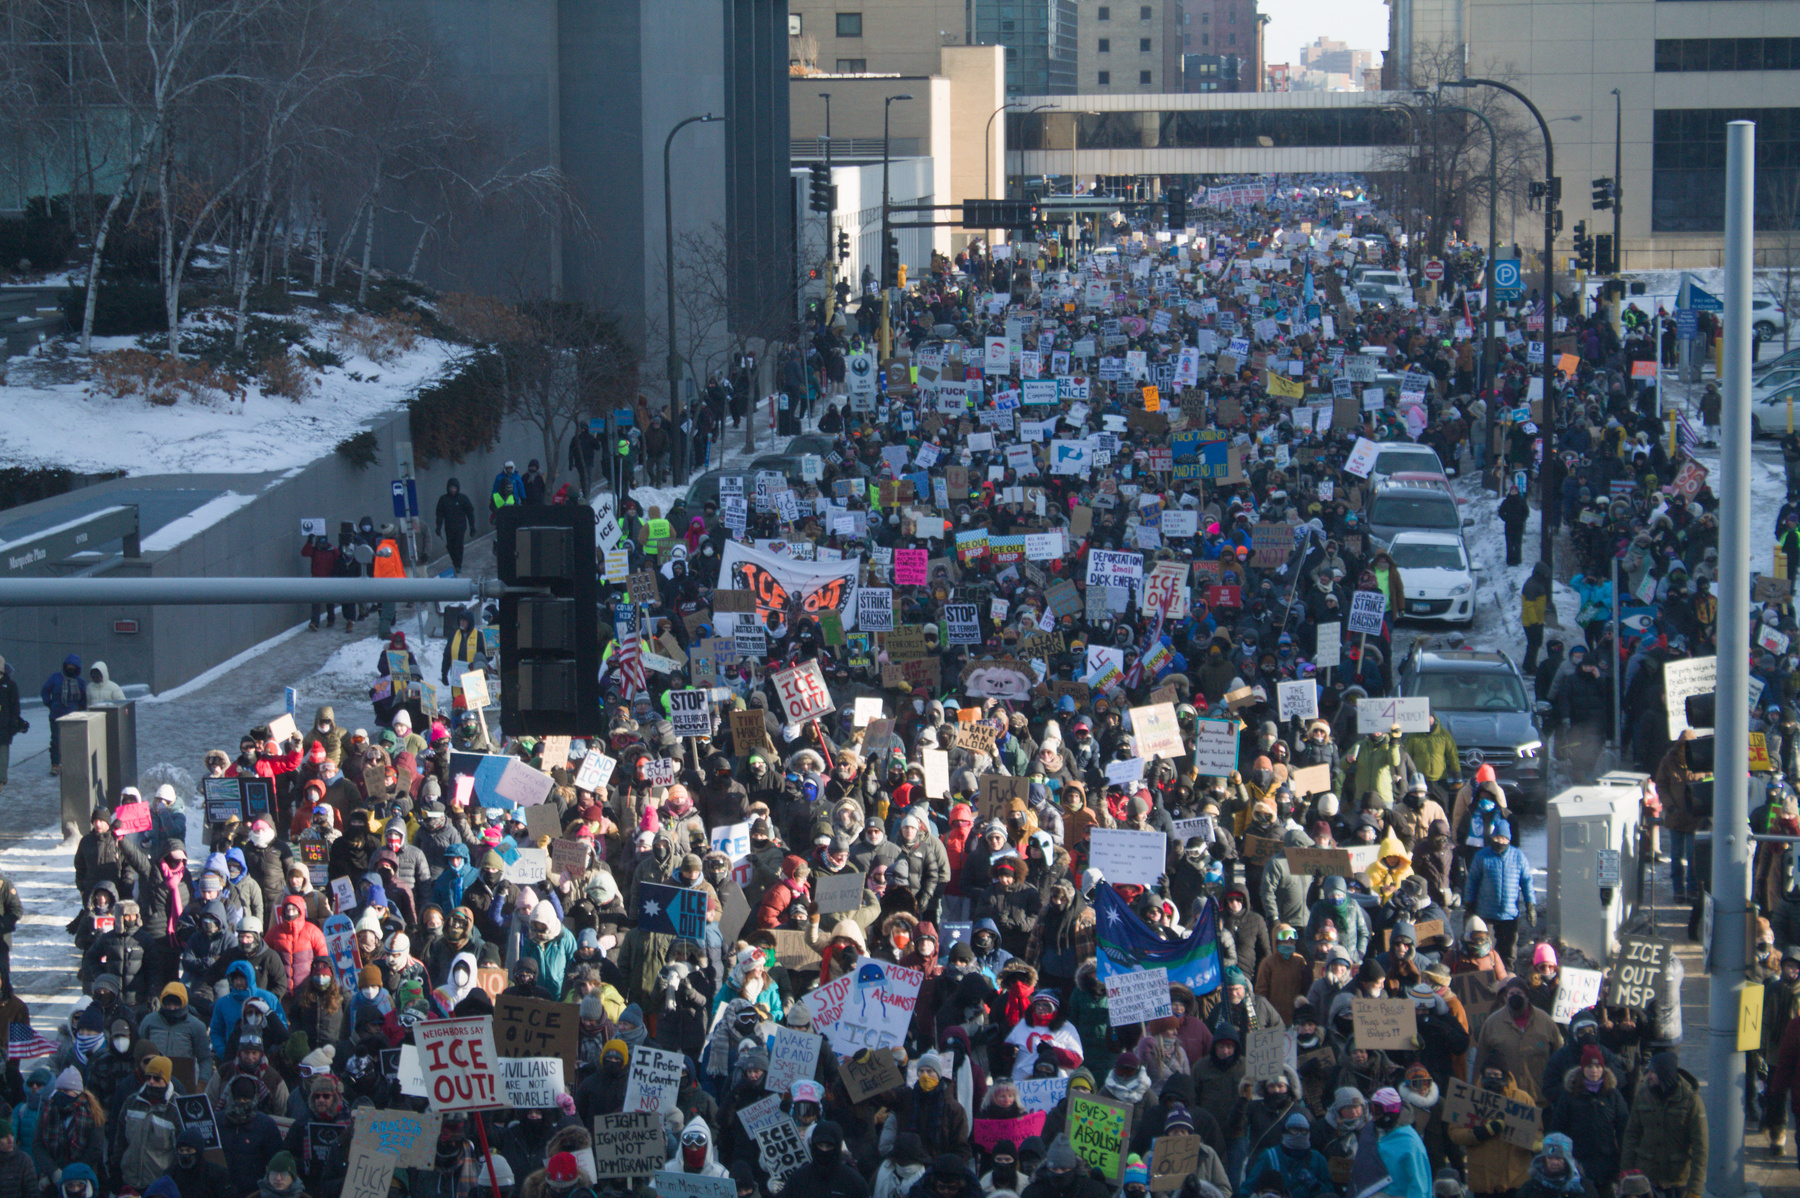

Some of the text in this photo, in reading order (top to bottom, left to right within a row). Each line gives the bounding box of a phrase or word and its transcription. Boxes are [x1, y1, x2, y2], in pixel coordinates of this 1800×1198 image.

[1501, 267, 1512, 281] P
[1230, 340, 1248, 353] NOPE
[1059, 378, 1071, 387] BE
[940, 387, 966, 396] FUCK
[1059, 387, 1087, 398] NICE
[1143, 387, 1157, 397] STOP
[1182, 390, 1202, 398] YOU
[944, 400, 961, 408] ICE
[997, 399, 1018, 410] ICE
[1173, 431, 1228, 442] FUCK AROUND
[1173, 463, 1228, 478] AND FIND OUT
[1143, 503, 1160, 518] ICE
[600, 521, 614, 540] ICE
[957, 538, 988, 550] ICE OUT
[990, 544, 1025, 554] ICE OUT
[9, 548, 47, 570] Marquette Plaza
[965, 548, 984, 557] MSP
[998, 553, 1019, 561] MSP
[1093, 551, 1143, 567] DEPORTATION
[1258, 548, 1284, 565] NOT
[1094, 561, 1134, 574] IS Small
[631, 573, 650, 584] ICE
[742, 563, 788, 609] ICE
[1090, 573, 1112, 587] DICK
[1149, 574, 1180, 593] ICE
[804, 578, 845, 612] OUT
[860, 596, 891, 609] STRIKE
[946, 606, 976, 622] STOP
[1353, 598, 1384, 614] STRIKE
[860, 613, 891, 626] RACISM
[1350, 612, 1382, 629] RACISM
[734, 625, 764, 633] JUSTICE FOR
[888, 627, 903, 638] ICE
[904, 626, 913, 636] IS
[915, 627, 921, 635] A
[948, 624, 978, 632] ICE TERROR
[736, 642, 766, 650] NICOLE GOOD
[888, 640, 924, 649] TERRORIST
[1031, 631, 1061, 647] LIAM
[1027, 642, 1063, 657] RAMOS
[781, 672, 819, 700] ICE
[1102, 677, 1117, 692] MSP
[1289, 685, 1304, 694] THE
[671, 691, 705, 711] STOP
[790, 690, 826, 717] OUT!
[1284, 701, 1304, 709] WORLD
[1286, 694, 1306, 702] WHOLE
[672, 714, 708, 723] ICE TERROR
[1283, 707, 1313, 716] WATCHING
[674, 722, 708, 730] NOW!
[737, 716, 759, 726] TINY
[737, 727, 766, 738] HANDS
[961, 723, 995, 737] LEAVE
[968, 733, 988, 743] MN
[587, 751, 613, 772] END
[646, 760, 671, 771] ICE
[581, 765, 608, 787] ICE
[647, 768, 668, 778] OUT
[1183, 818, 1209, 829] PREFER
[305, 844, 327, 853] FUCK
[713, 836, 747, 856] ICE
[309, 852, 323, 860] ICE
[1356, 852, 1366, 862] MY
[1626, 942, 1664, 964] ICE
[886, 965, 923, 987] MOMS
[1569, 974, 1598, 989] TINY
[1621, 965, 1661, 986] OUT
[813, 977, 851, 1012] STOP
[871, 988, 917, 1012] AGAINST
[1558, 988, 1589, 1005] DICK
[1615, 984, 1656, 1009] MSP
[502, 1004, 560, 1028] ICE
[1743, 1003, 1759, 1034] N
[422, 1026, 485, 1040] NEIGHBORS SAY
[505, 1025, 555, 1048] OUT
[841, 1021, 898, 1049] ICE
[1254, 1029, 1279, 1048] EAT
[780, 1034, 813, 1050] WAKE
[426, 1039, 488, 1072] ICE
[776, 1047, 814, 1063] UP AND
[1248, 1046, 1280, 1064] SHIT
[774, 1060, 810, 1076] SMELL
[1252, 1061, 1279, 1080] ICE
[434, 1074, 496, 1104] OUT!
[505, 1080, 546, 1090] ARE NOT
[1016, 1079, 1068, 1095] JUSTICE
[640, 1097, 659, 1111] NO
[1454, 1084, 1468, 1100] I
[1470, 1090, 1501, 1109] LIKE
[604, 1113, 651, 1129] FIGHT
[379, 1133, 415, 1149] ICE!
[597, 1129, 657, 1145] IGNORANCE
[760, 1123, 794, 1145] ICE
[1074, 1124, 1121, 1154] ABOLISH
[615, 1142, 645, 1156] NOT
[765, 1138, 799, 1158] OUT
[1161, 1138, 1194, 1156] ICE
[781, 1149, 806, 1166] OF
[1078, 1145, 1108, 1166] ICE
[599, 1155, 664, 1174] IMMIGRANTS
[1158, 1155, 1198, 1175] OUT
[353, 1154, 391, 1192] FUCK
